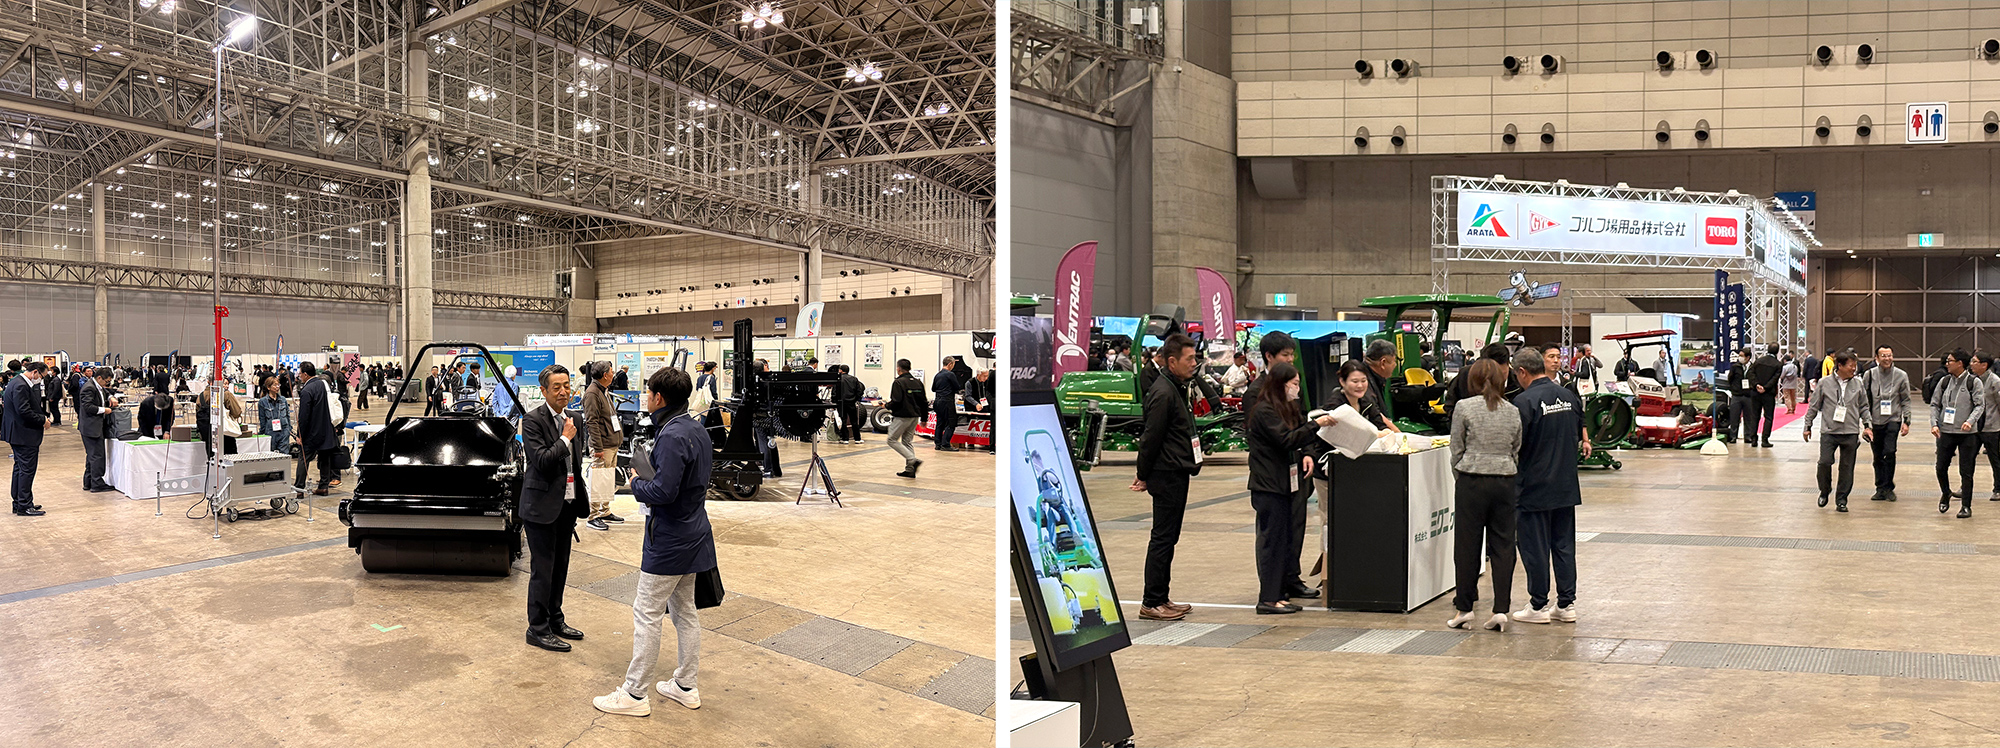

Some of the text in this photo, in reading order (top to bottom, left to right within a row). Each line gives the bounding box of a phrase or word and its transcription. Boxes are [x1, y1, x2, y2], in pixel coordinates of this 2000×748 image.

[1800, 195, 1809, 208] 2
[1466, 228, 1495, 237] ARATA
[1569, 216, 1687, 237] ゴルフ場用品株式会社
[1707, 225, 1736, 238] TORO
[1055, 270, 1088, 367] VENTRAC
